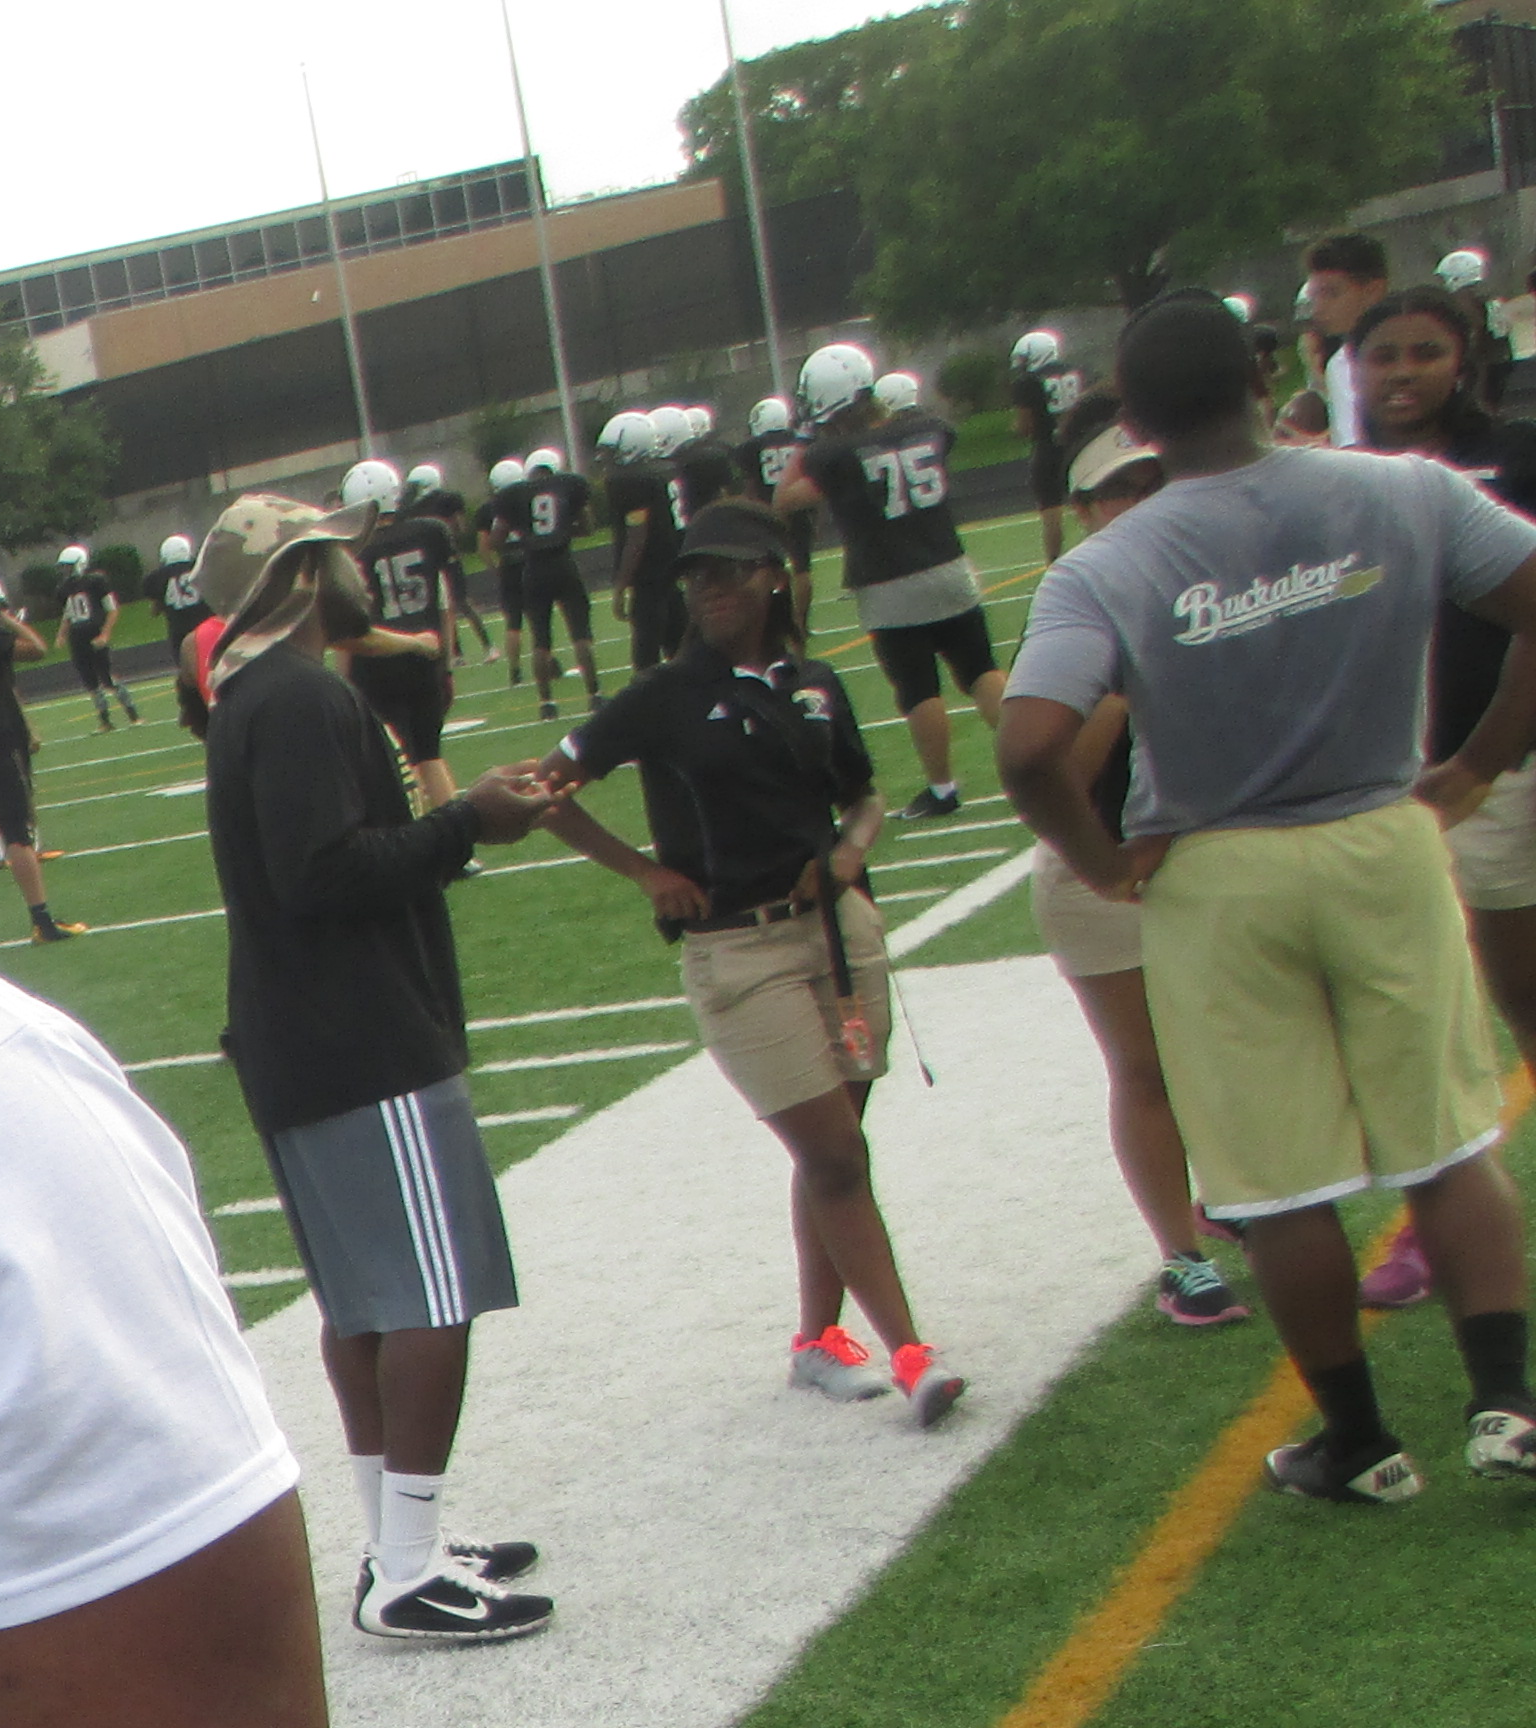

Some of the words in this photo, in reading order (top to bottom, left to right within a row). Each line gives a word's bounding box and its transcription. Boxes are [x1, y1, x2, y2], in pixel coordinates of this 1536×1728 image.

[531, 494, 557, 535] 9
[862, 444, 946, 520] 75
[374, 549, 429, 619] 15
[1173, 553, 1362, 645] Buckalew
